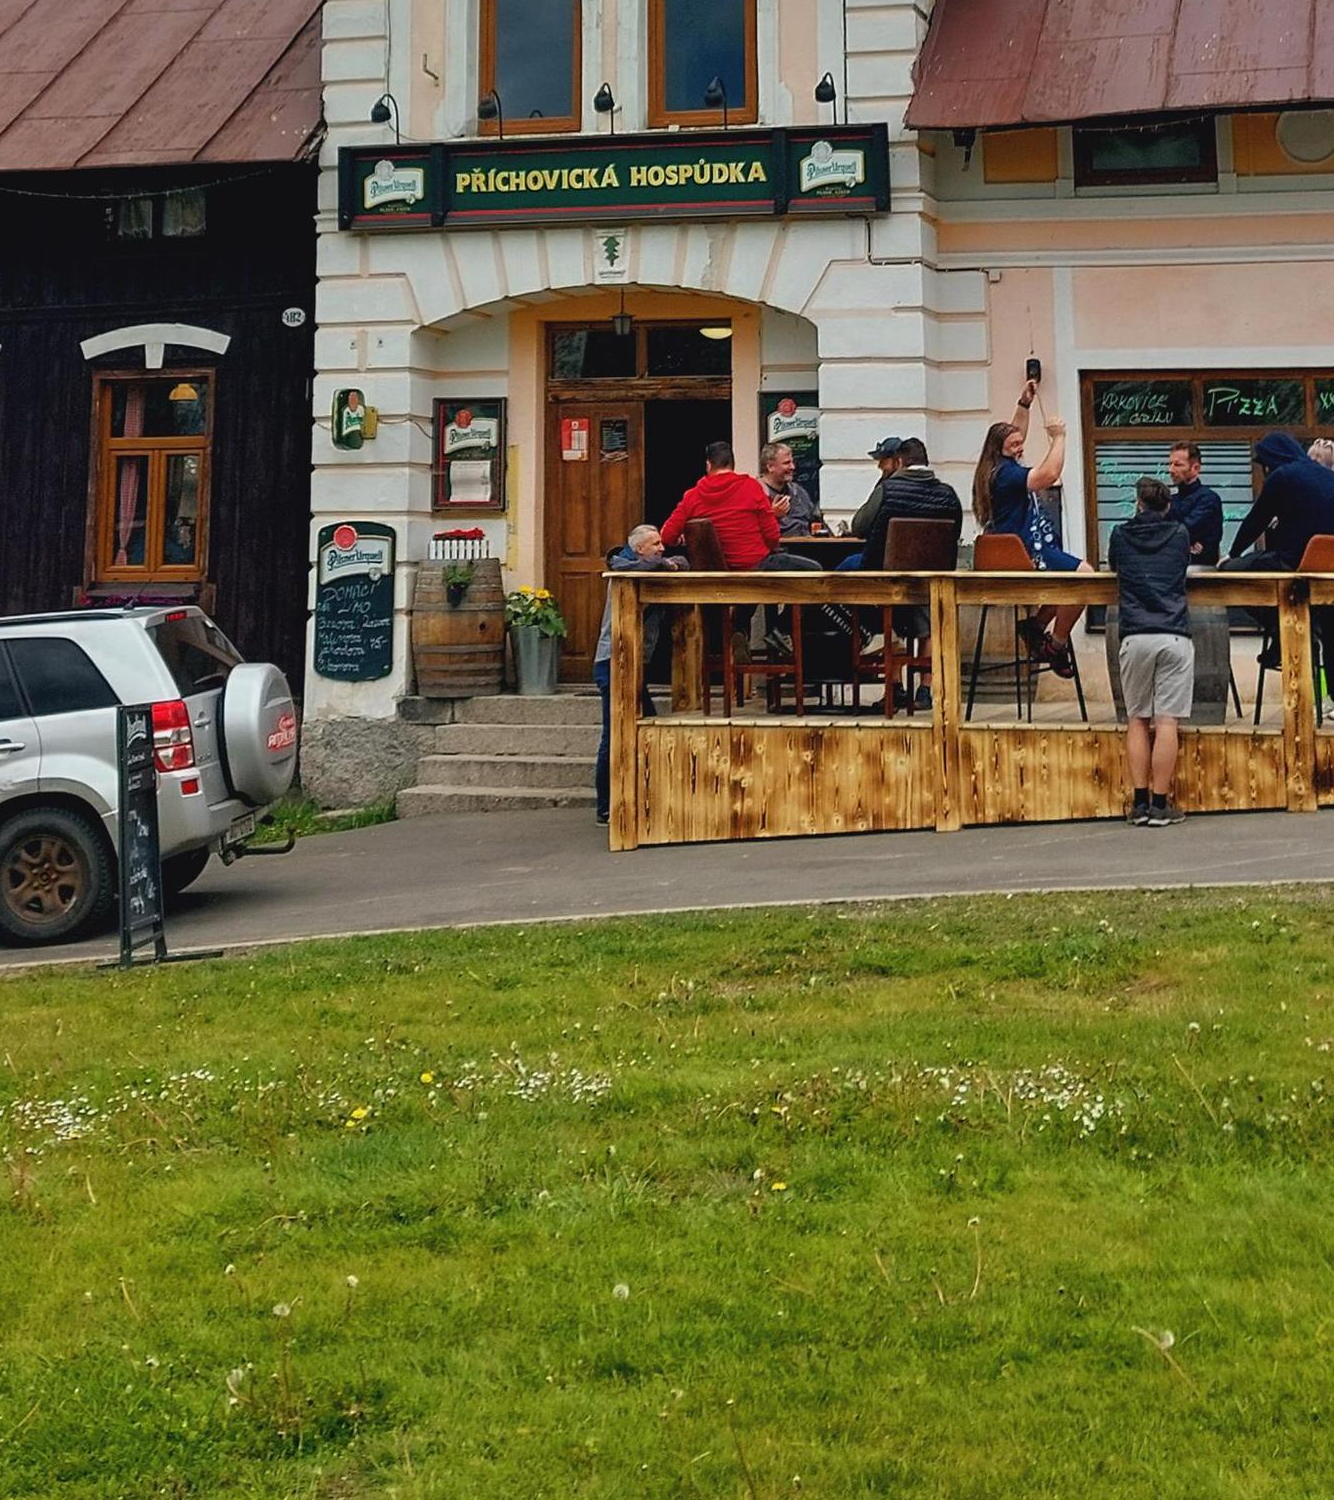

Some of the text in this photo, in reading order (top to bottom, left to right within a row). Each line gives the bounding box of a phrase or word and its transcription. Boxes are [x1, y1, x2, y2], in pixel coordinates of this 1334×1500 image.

[455, 158, 767, 193] PŘÍCHOVICKÁ HOSPŮDKA
[327, 548, 383, 571] Pilsner Urquell
